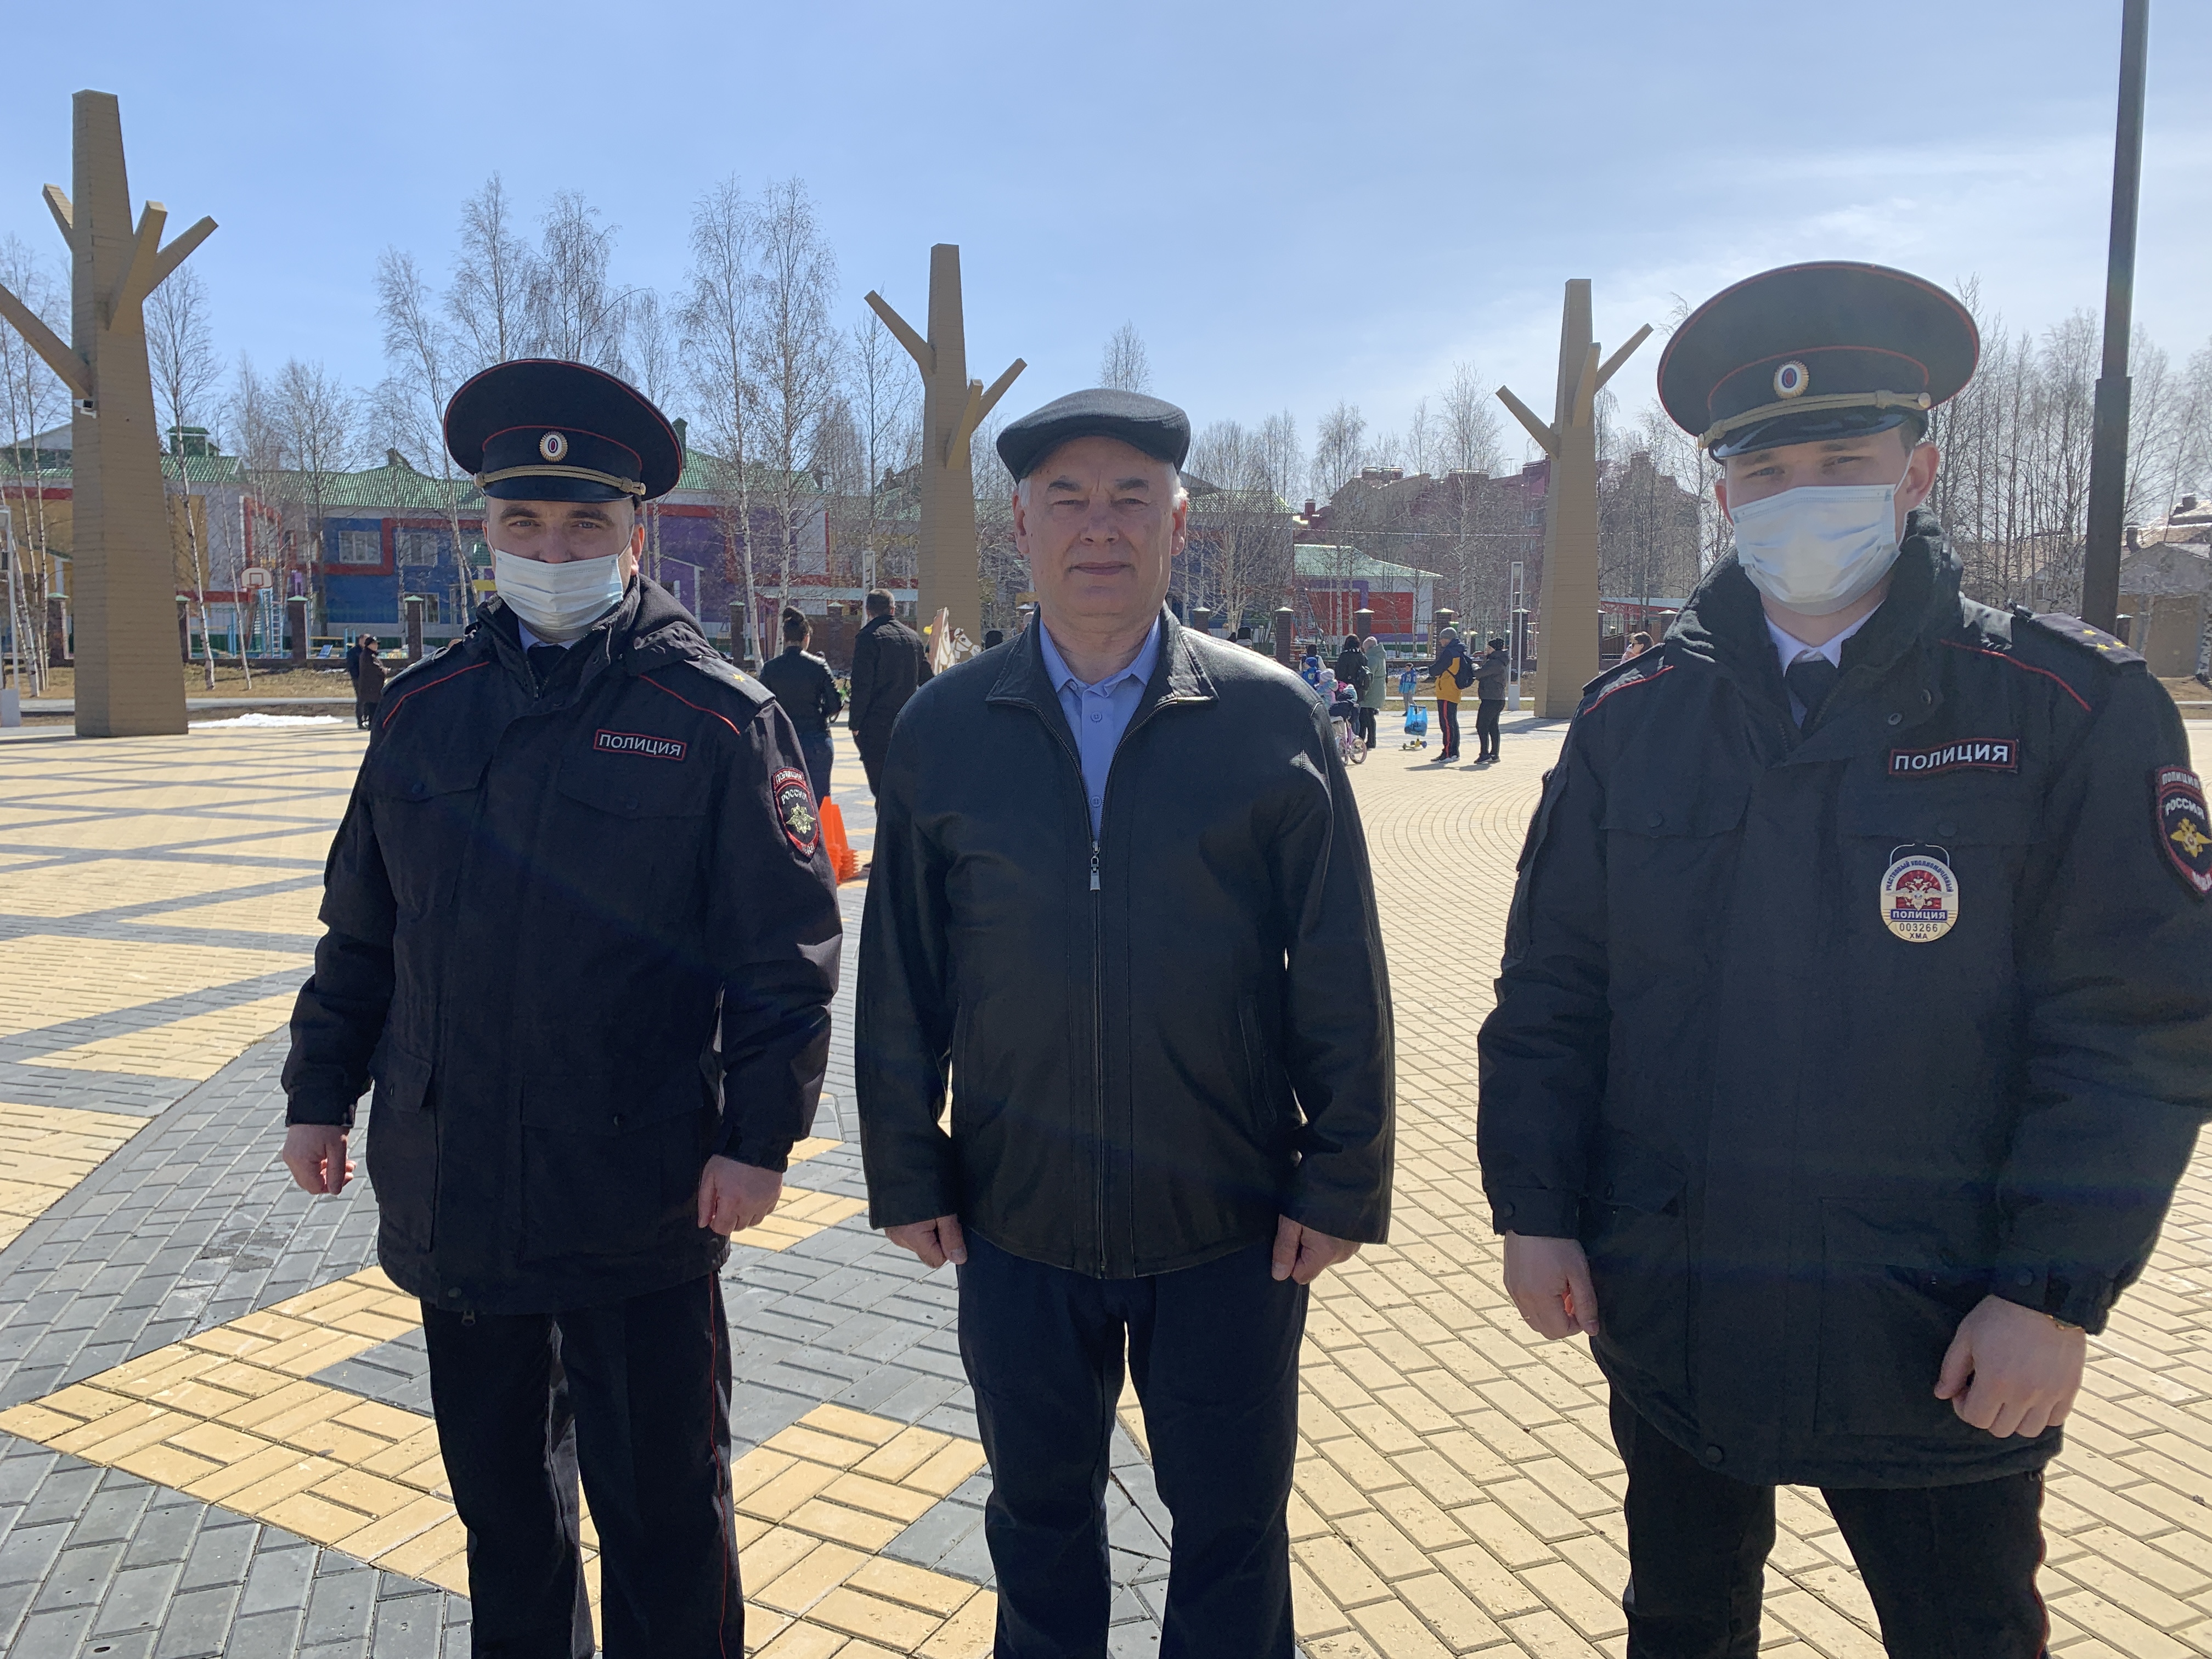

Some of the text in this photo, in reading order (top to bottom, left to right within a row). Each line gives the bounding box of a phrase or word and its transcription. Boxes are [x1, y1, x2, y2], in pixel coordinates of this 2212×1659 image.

[599, 733, 681, 756] ПОЛИЦИЯ
[1895, 743, 2008, 770] ПОЛИЦИЯ
[2162, 771, 2200, 789] ПОЛИЦИЯ
[781, 789, 808, 805] РОССИЯ
[2165, 797, 2205, 820] РОССИЯ
[1886, 860, 1954, 893] УЧАСТКОВЫЙ УПОЛНОМОЧЕННЫЙ
[1892, 911, 1946, 921] ПОЛИЦИЯ
[1899, 923, 1938, 932] 003266
